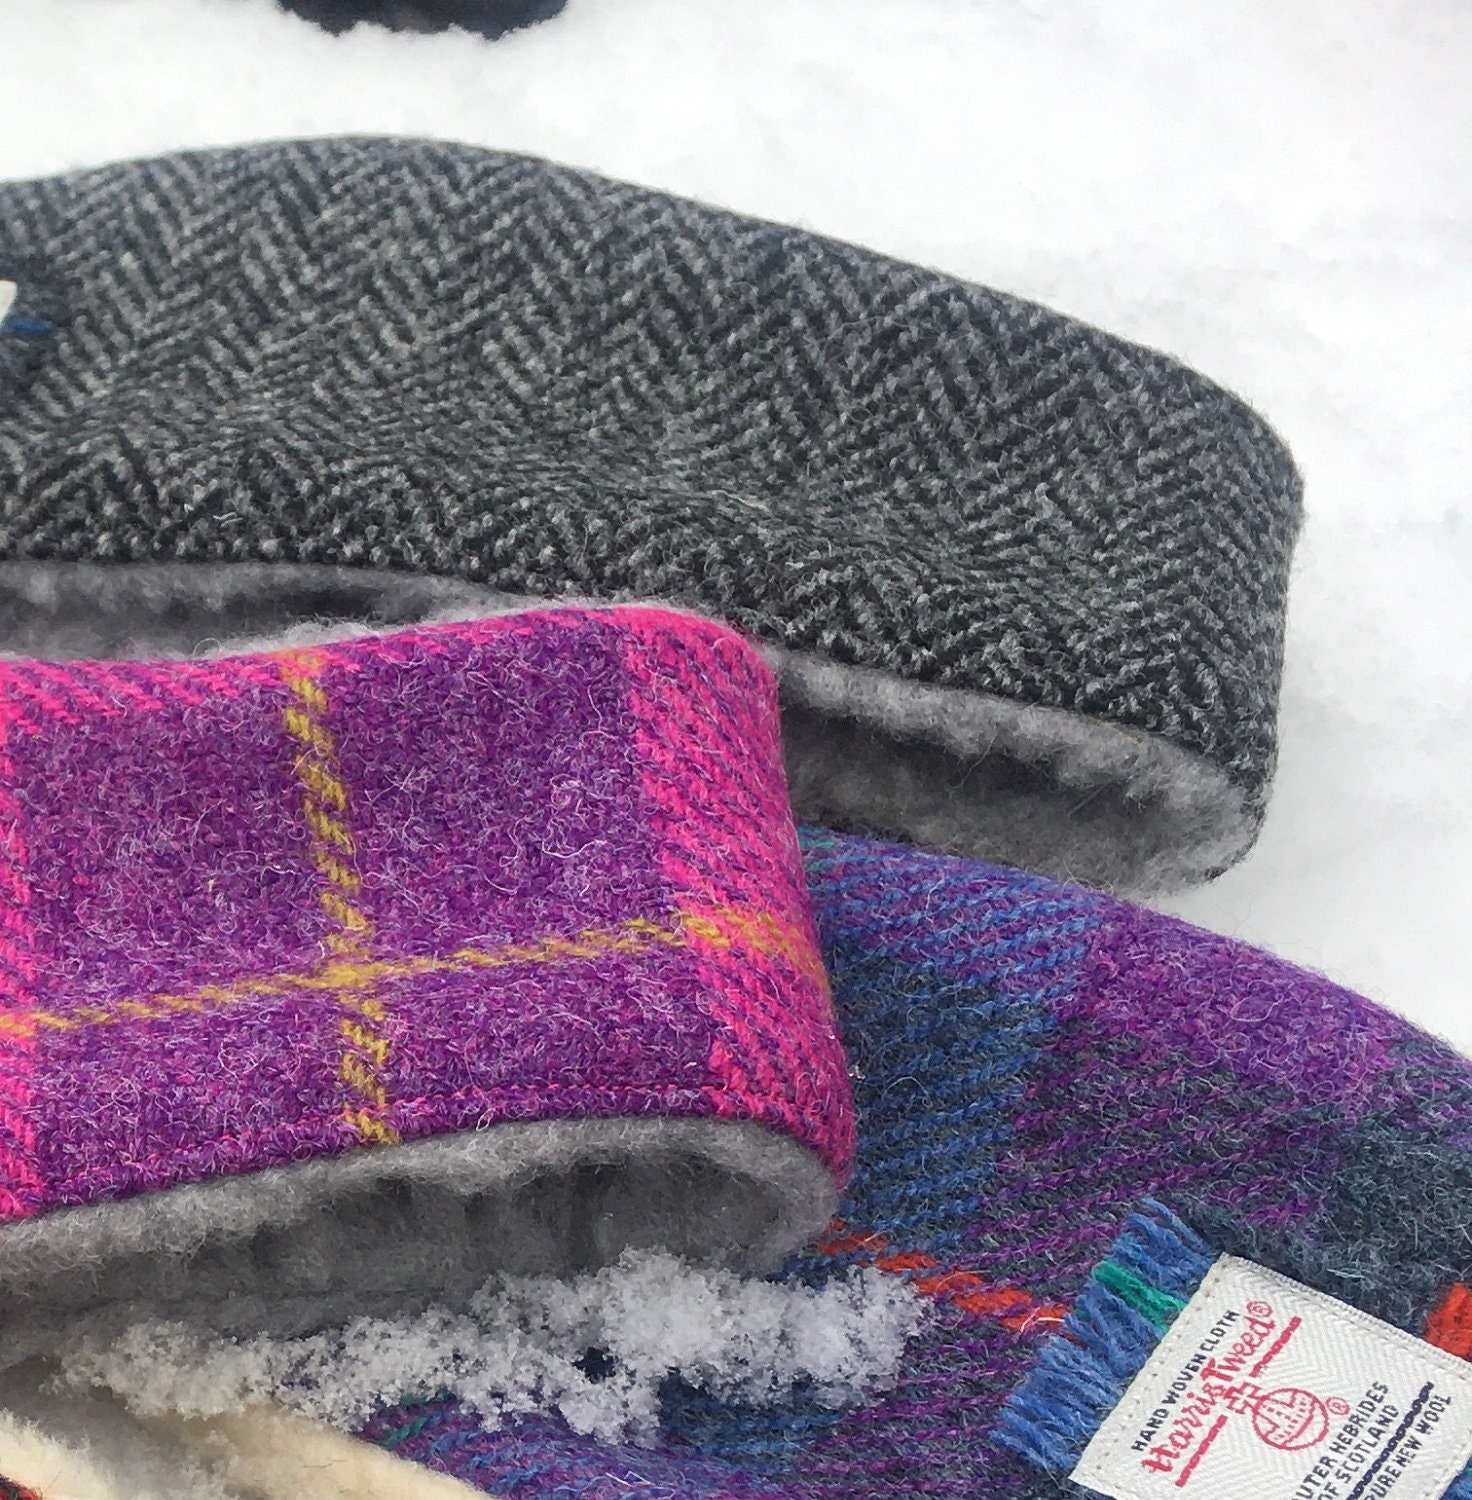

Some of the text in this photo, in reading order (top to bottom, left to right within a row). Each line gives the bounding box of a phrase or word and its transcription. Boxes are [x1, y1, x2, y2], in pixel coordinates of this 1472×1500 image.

[1131, 1310, 1240, 1452] HAND WOVEN CLOTH
[1329, 1381, 1390, 1455] HEBRIDES
[1141, 1382, 1226, 1474] Harris
[1336, 1404, 1400, 1484] SCOTLAND
[1392, 1435, 1423, 1469] NEW
[1415, 1394, 1452, 1435] WOOL
